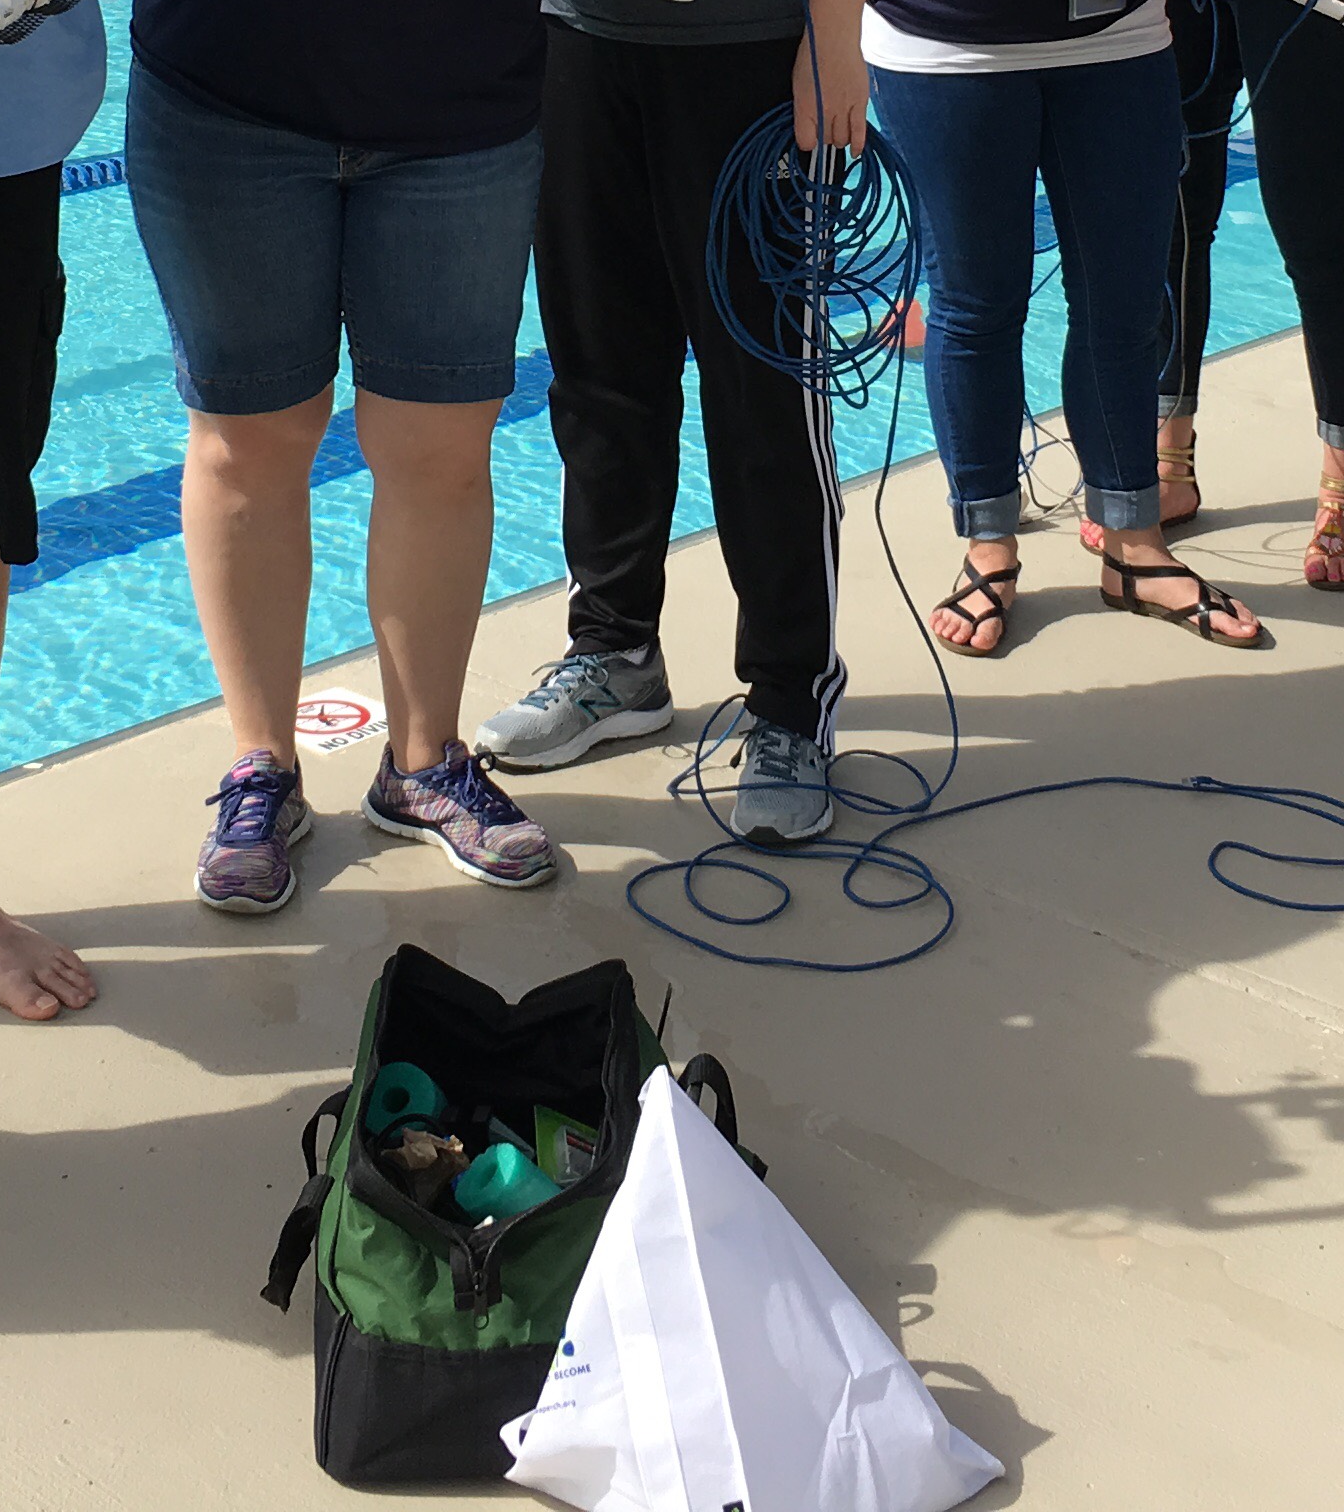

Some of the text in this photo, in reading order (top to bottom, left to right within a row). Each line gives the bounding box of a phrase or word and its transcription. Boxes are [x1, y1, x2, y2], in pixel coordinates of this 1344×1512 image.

[318, 717, 390, 751] NO DIVI
[554, 1363, 591, 1380] BECOME
